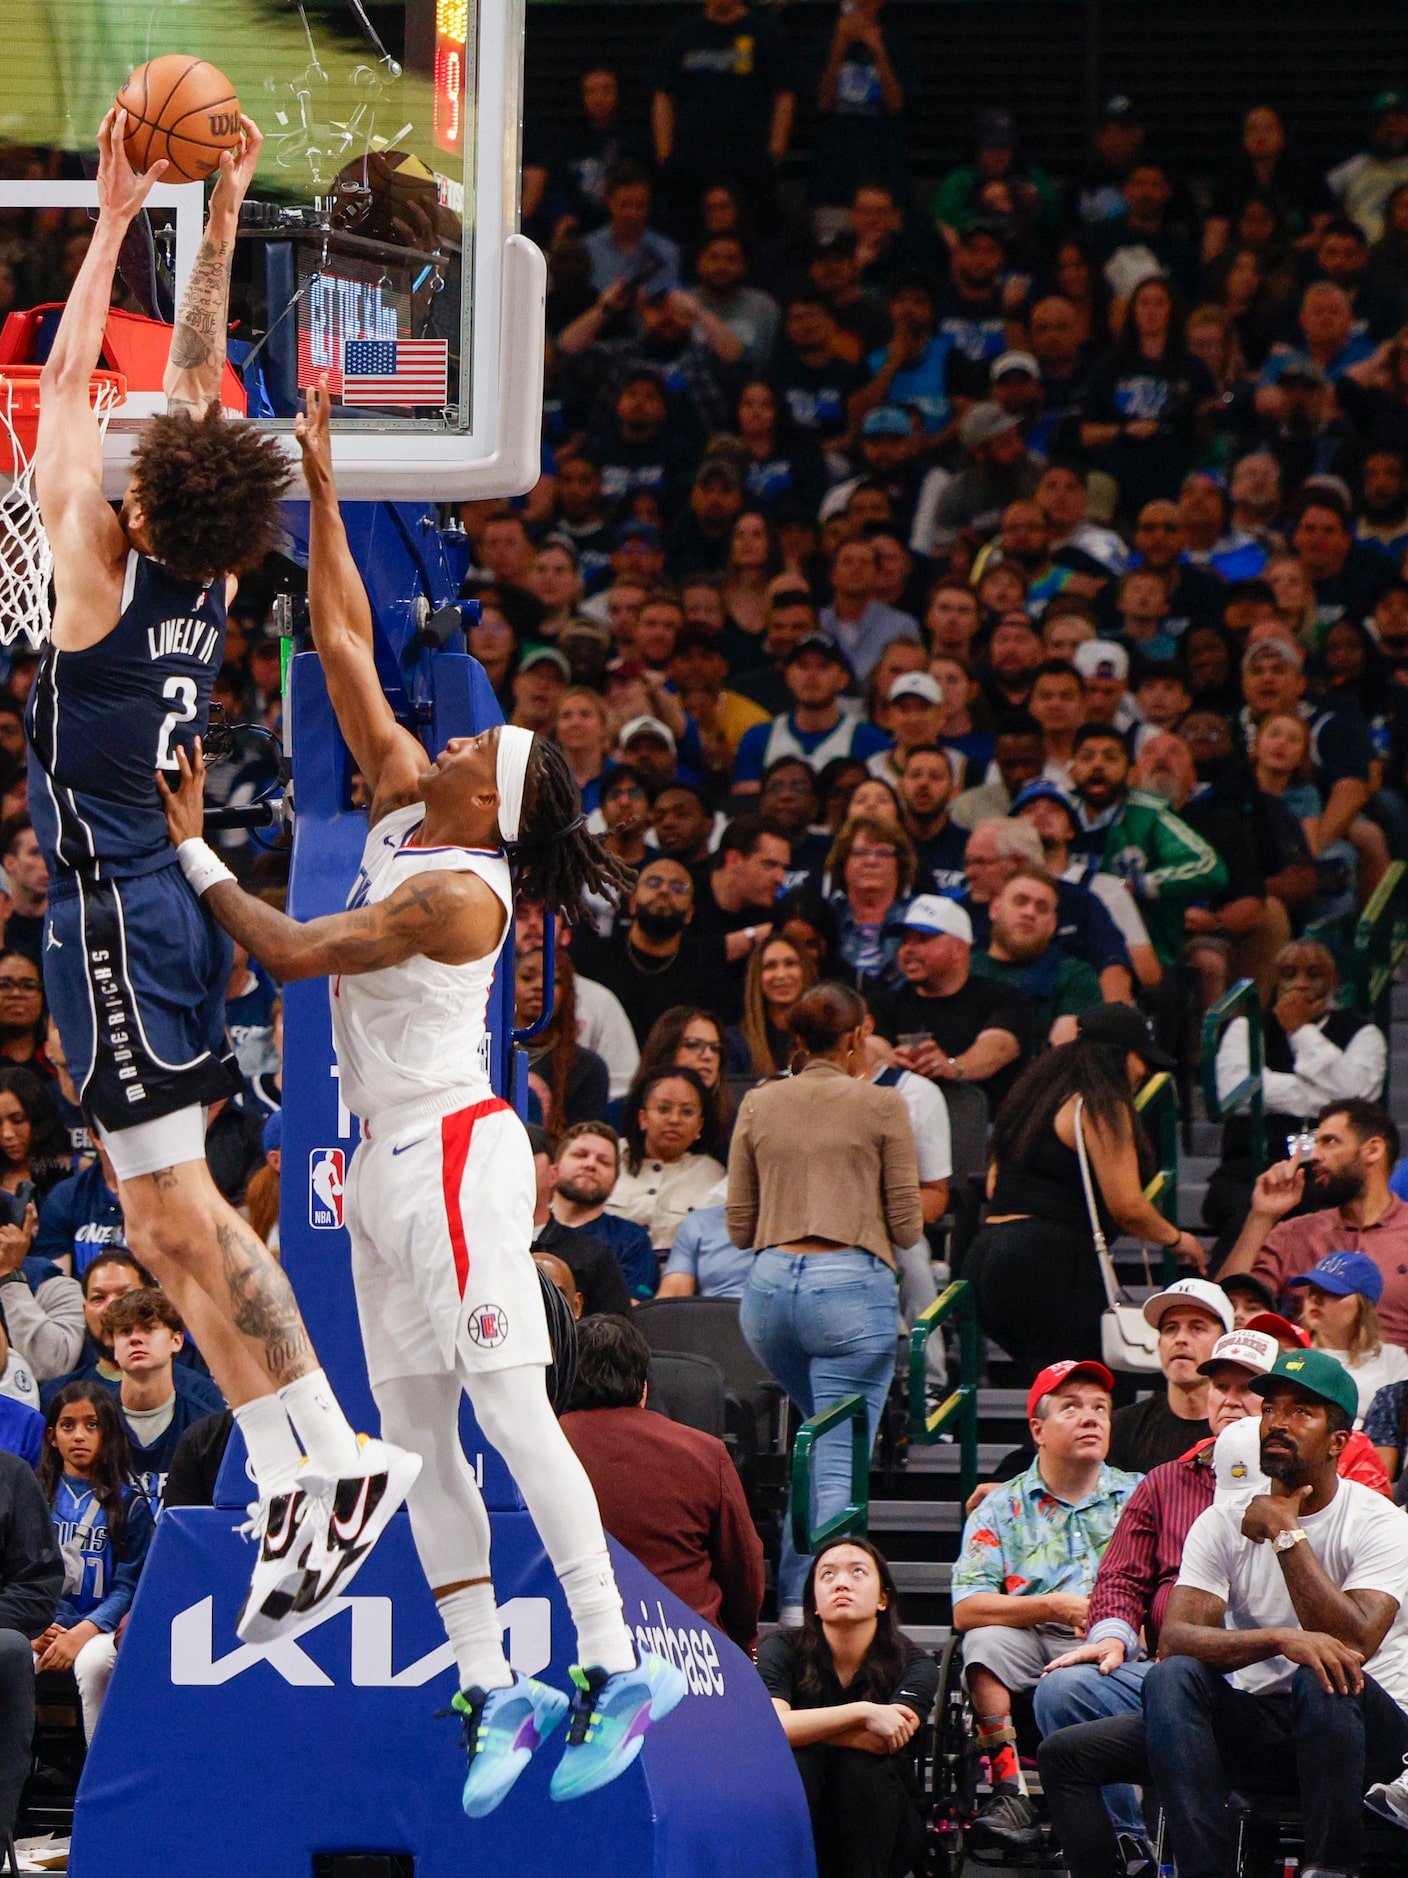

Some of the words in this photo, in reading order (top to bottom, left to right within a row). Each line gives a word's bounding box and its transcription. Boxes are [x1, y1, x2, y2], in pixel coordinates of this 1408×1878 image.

[147, 617, 208, 661] LIVELY
[198, 626, 219, 664] II
[155, 676, 198, 771] 2
[74, 1221, 113, 1244] ONE
[314, 1211, 332, 1224] NBA
